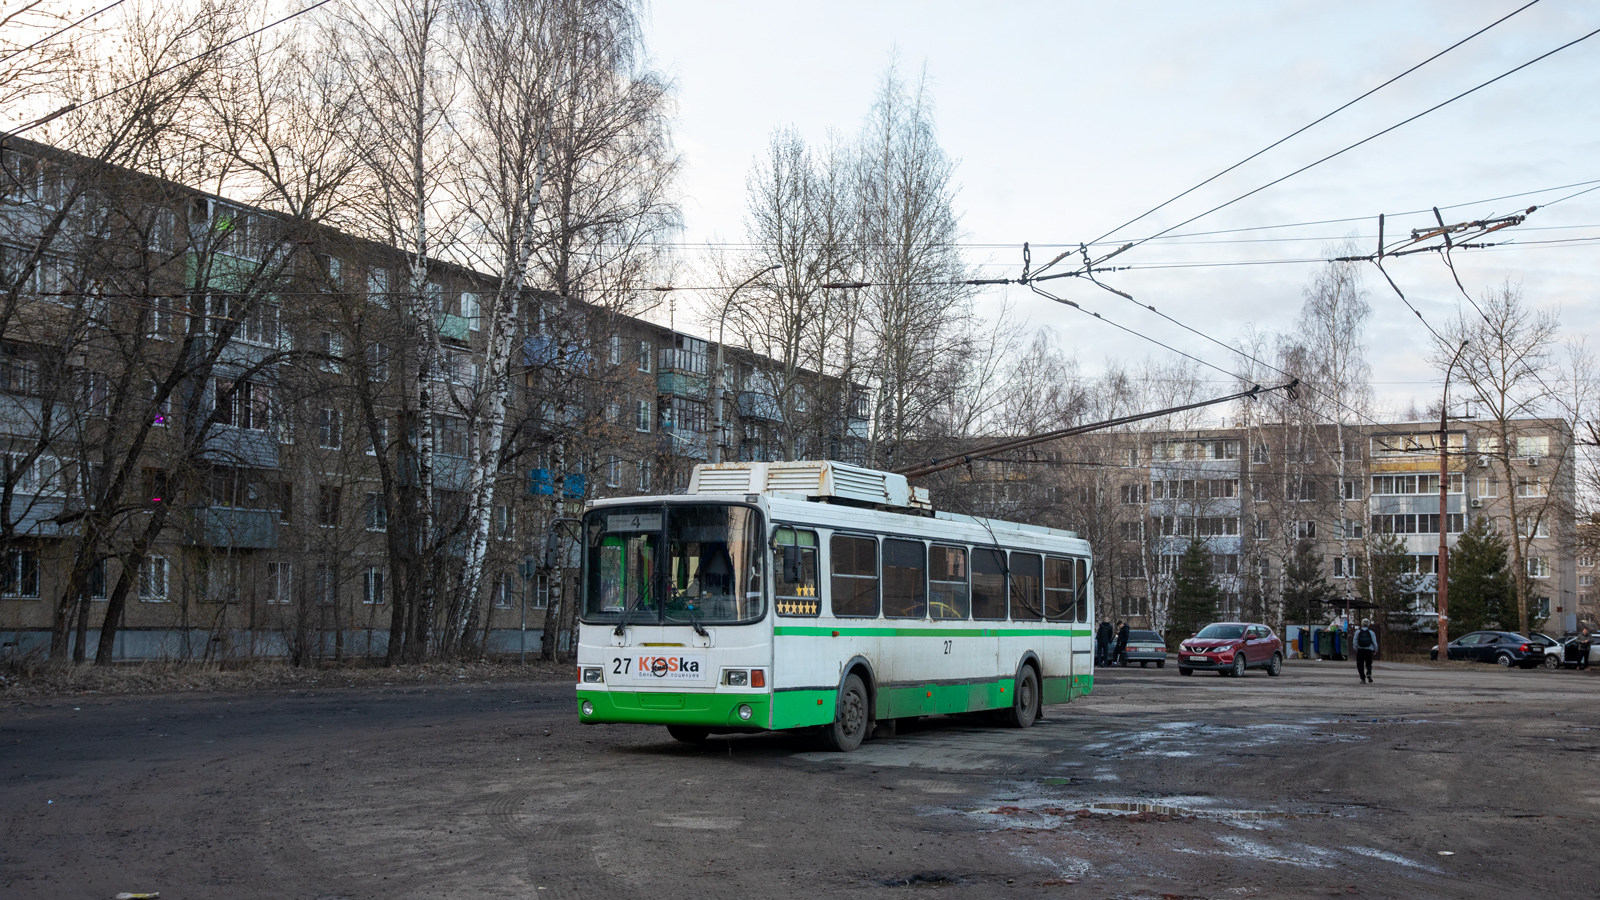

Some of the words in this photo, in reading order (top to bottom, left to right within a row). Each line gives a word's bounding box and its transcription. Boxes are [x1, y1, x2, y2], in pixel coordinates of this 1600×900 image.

[631, 515, 641, 528] 4
[943, 640, 952, 655] 27
[612, 657, 632, 675] 27
